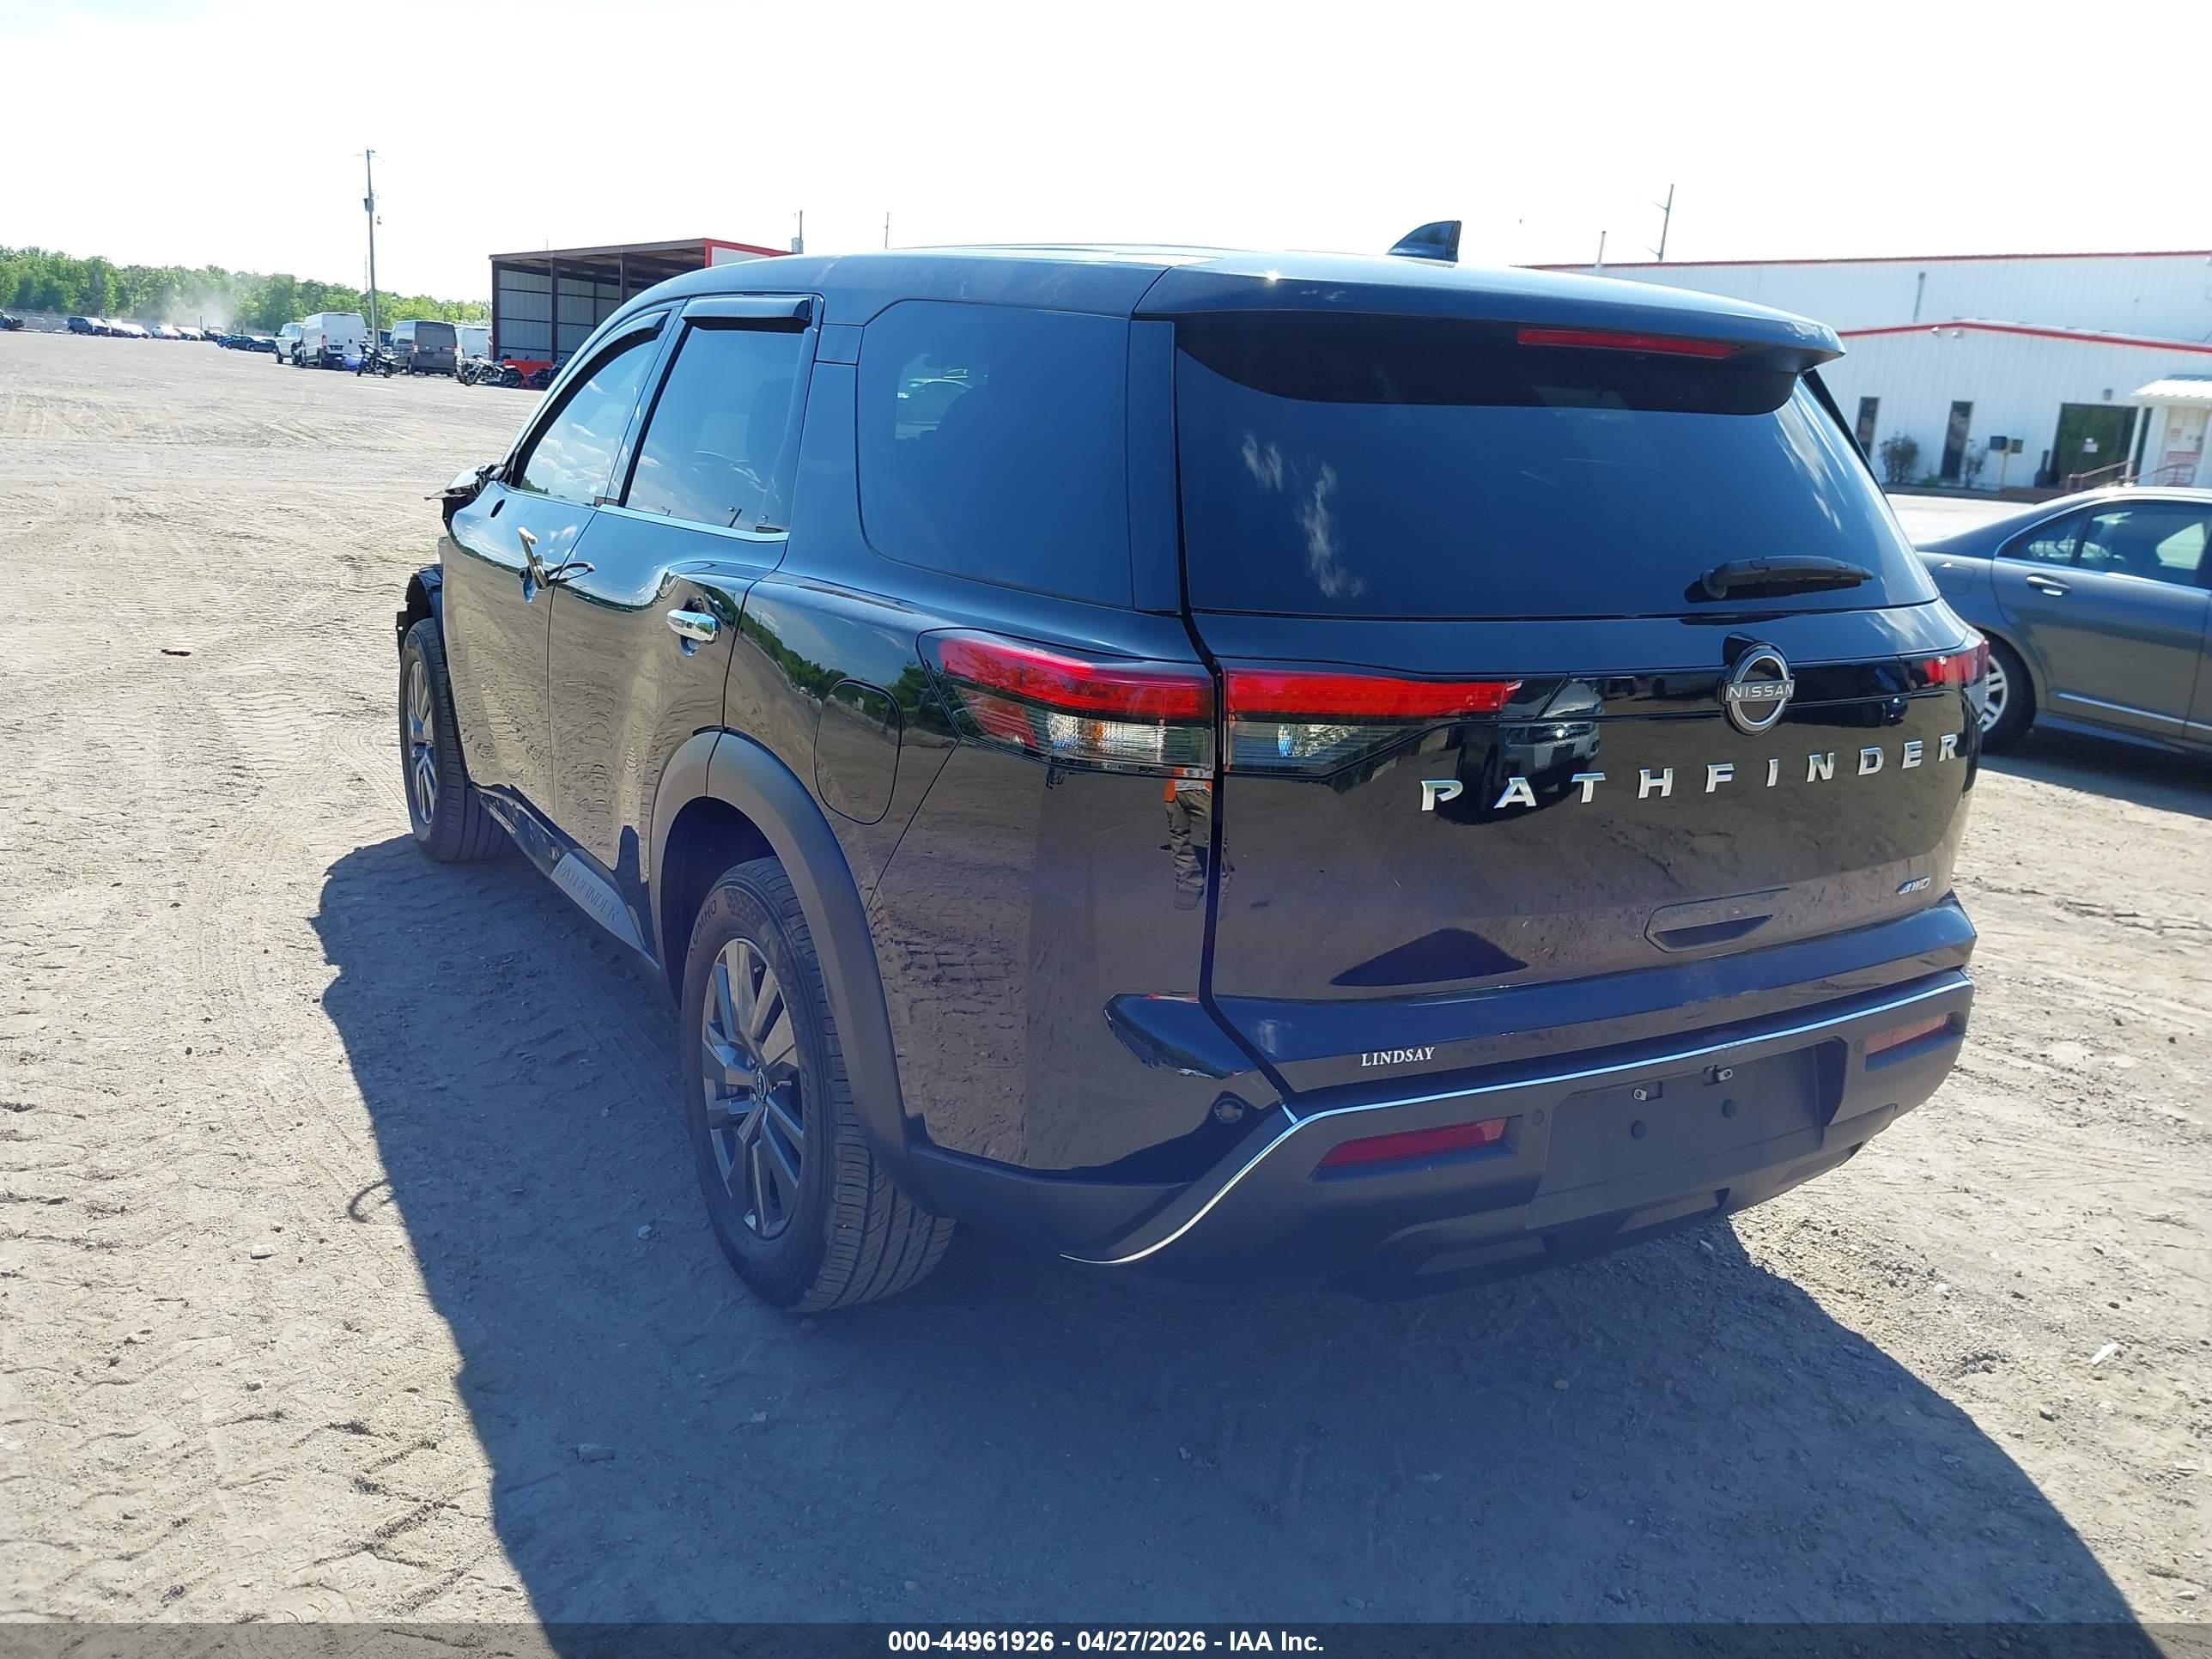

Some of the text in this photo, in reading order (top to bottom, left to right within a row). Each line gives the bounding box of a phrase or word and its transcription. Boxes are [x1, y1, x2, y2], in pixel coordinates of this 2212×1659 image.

[1729, 684, 1794, 698] NISSAN
[1420, 732, 1960, 811] PATHFINDER
[1360, 1046, 1436, 1066] LINDSAY
